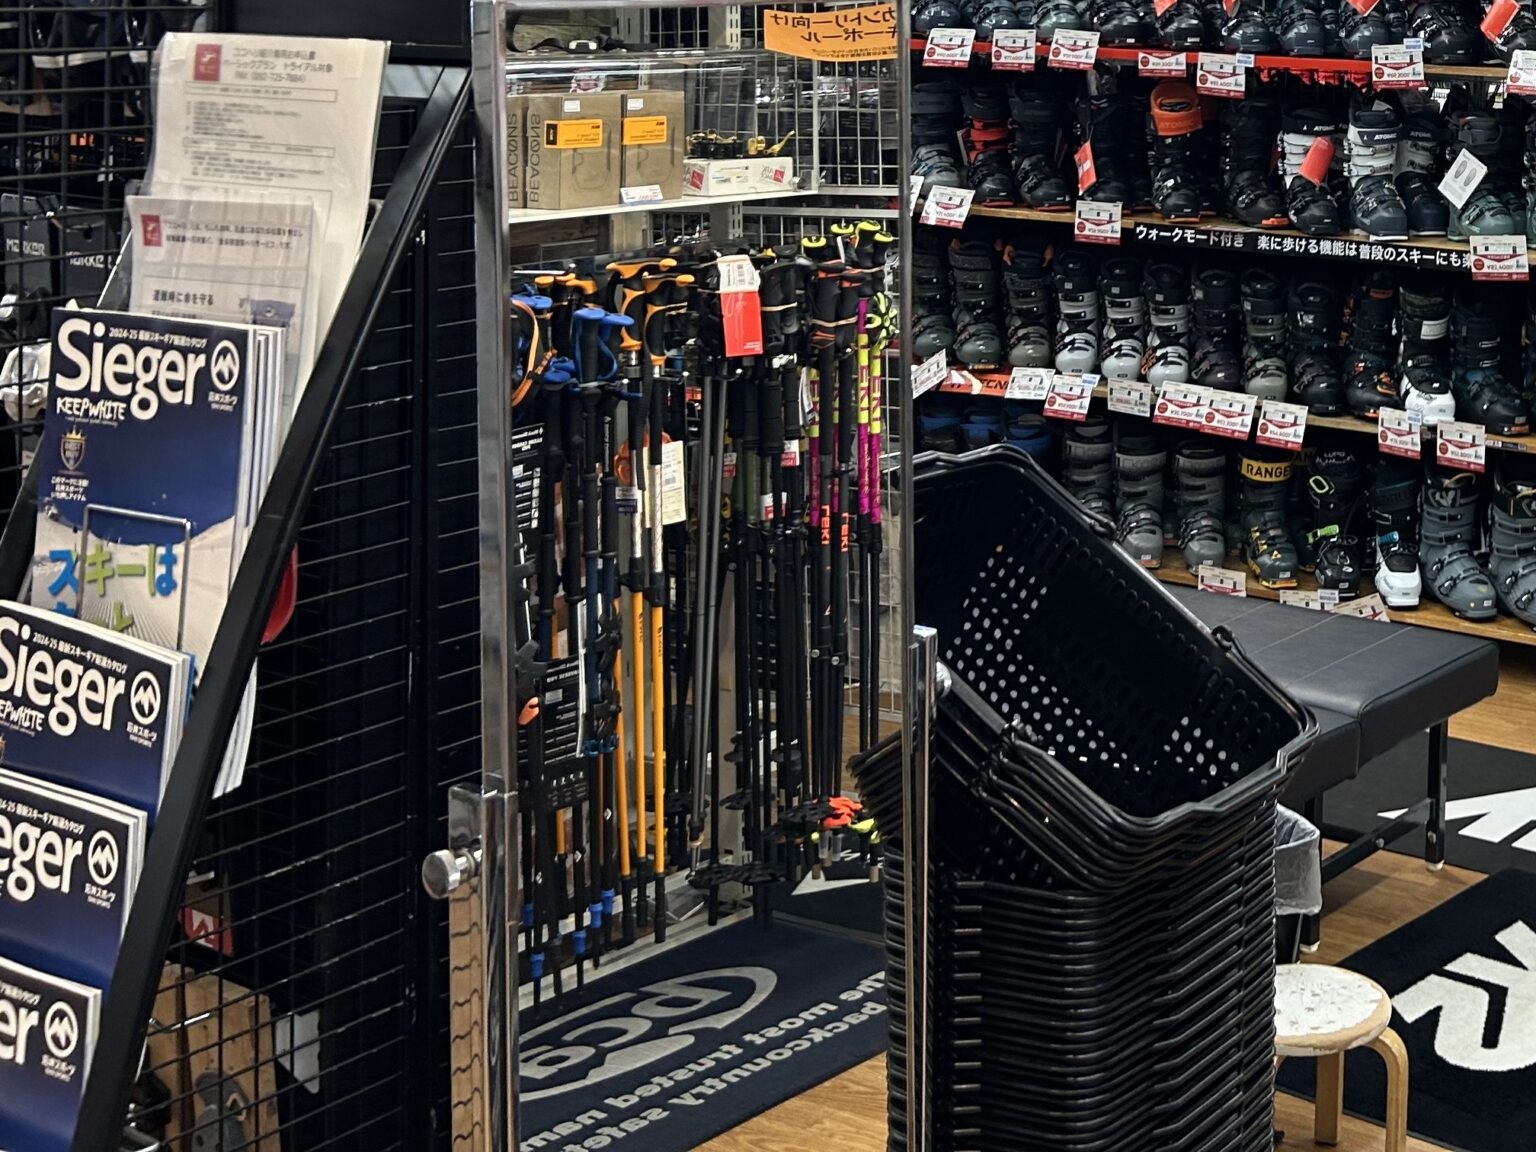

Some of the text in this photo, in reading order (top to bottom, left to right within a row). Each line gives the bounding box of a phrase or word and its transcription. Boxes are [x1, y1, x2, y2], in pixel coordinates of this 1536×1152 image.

[1136, 226, 1245, 248] ウォークモード付き
[56, 318, 207, 421] Sieger
[0, 616, 126, 736] Sieger
[0, 814, 83, 902] eger
